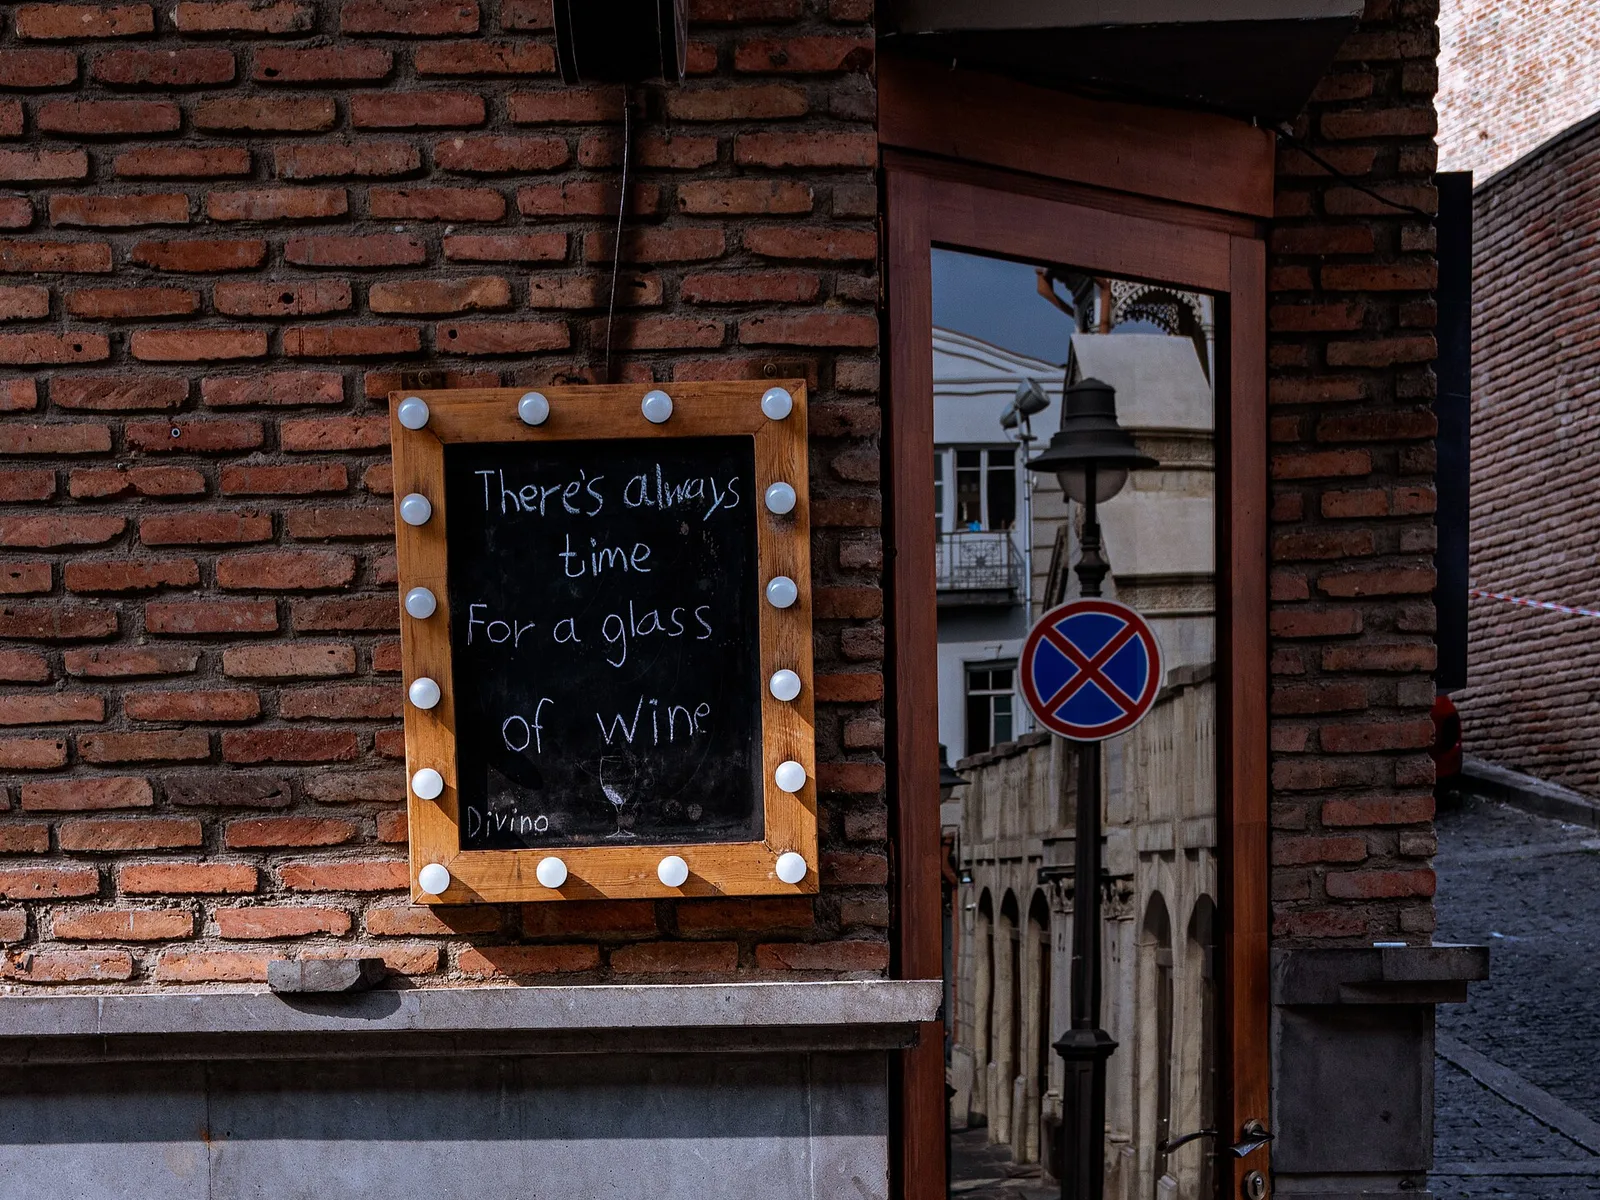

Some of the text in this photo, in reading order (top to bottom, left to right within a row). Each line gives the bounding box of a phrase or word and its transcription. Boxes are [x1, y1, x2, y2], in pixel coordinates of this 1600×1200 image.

[474, 463, 740, 522] There's always
[558, 533, 652, 578] time
[467, 600, 713, 668] For a glass
[467, 806, 550, 838] Divino
